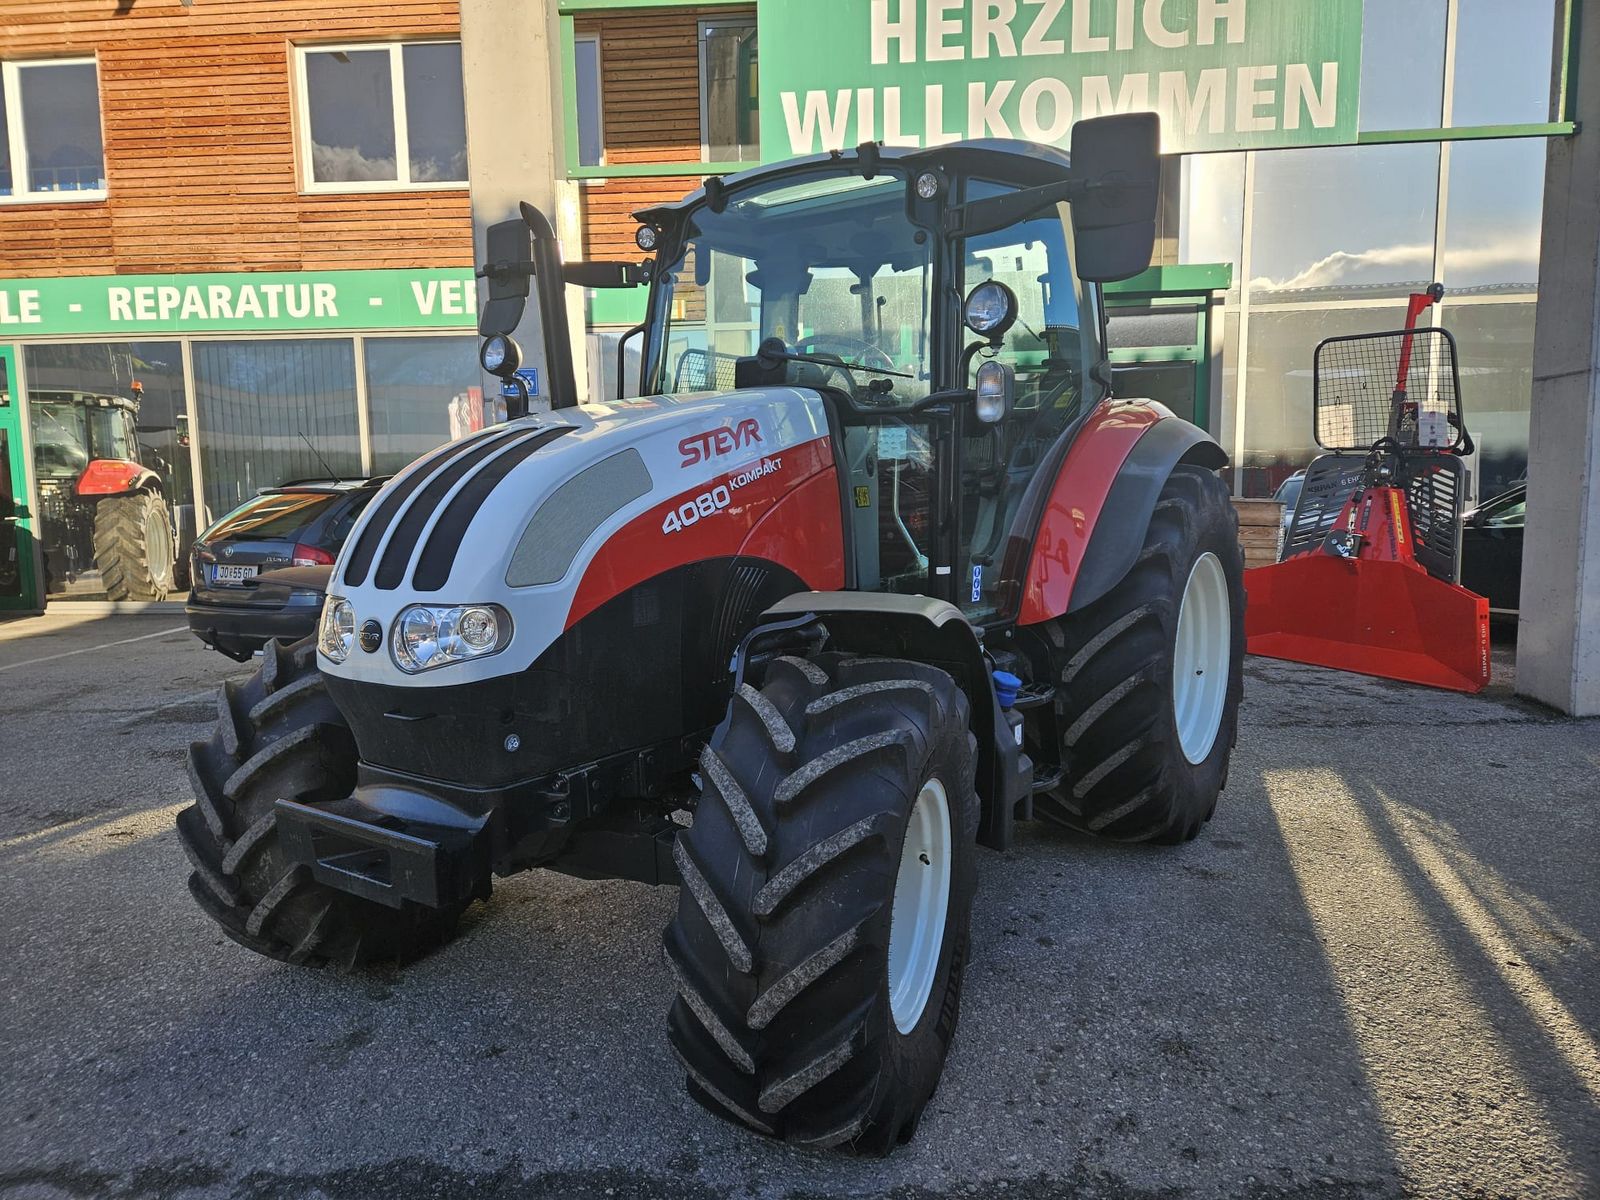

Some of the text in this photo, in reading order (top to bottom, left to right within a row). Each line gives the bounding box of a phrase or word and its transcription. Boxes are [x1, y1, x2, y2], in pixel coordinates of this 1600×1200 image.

[868, 0, 1248, 65] HERZLICH
[780, 61, 1339, 155] WILLKOMMEN
[0, 289, 42, 324] LE
[107, 283, 340, 322] REPARATUR
[678, 418, 763, 469] STEYR
[661, 458, 783, 535] 4080 KOMPAKT
